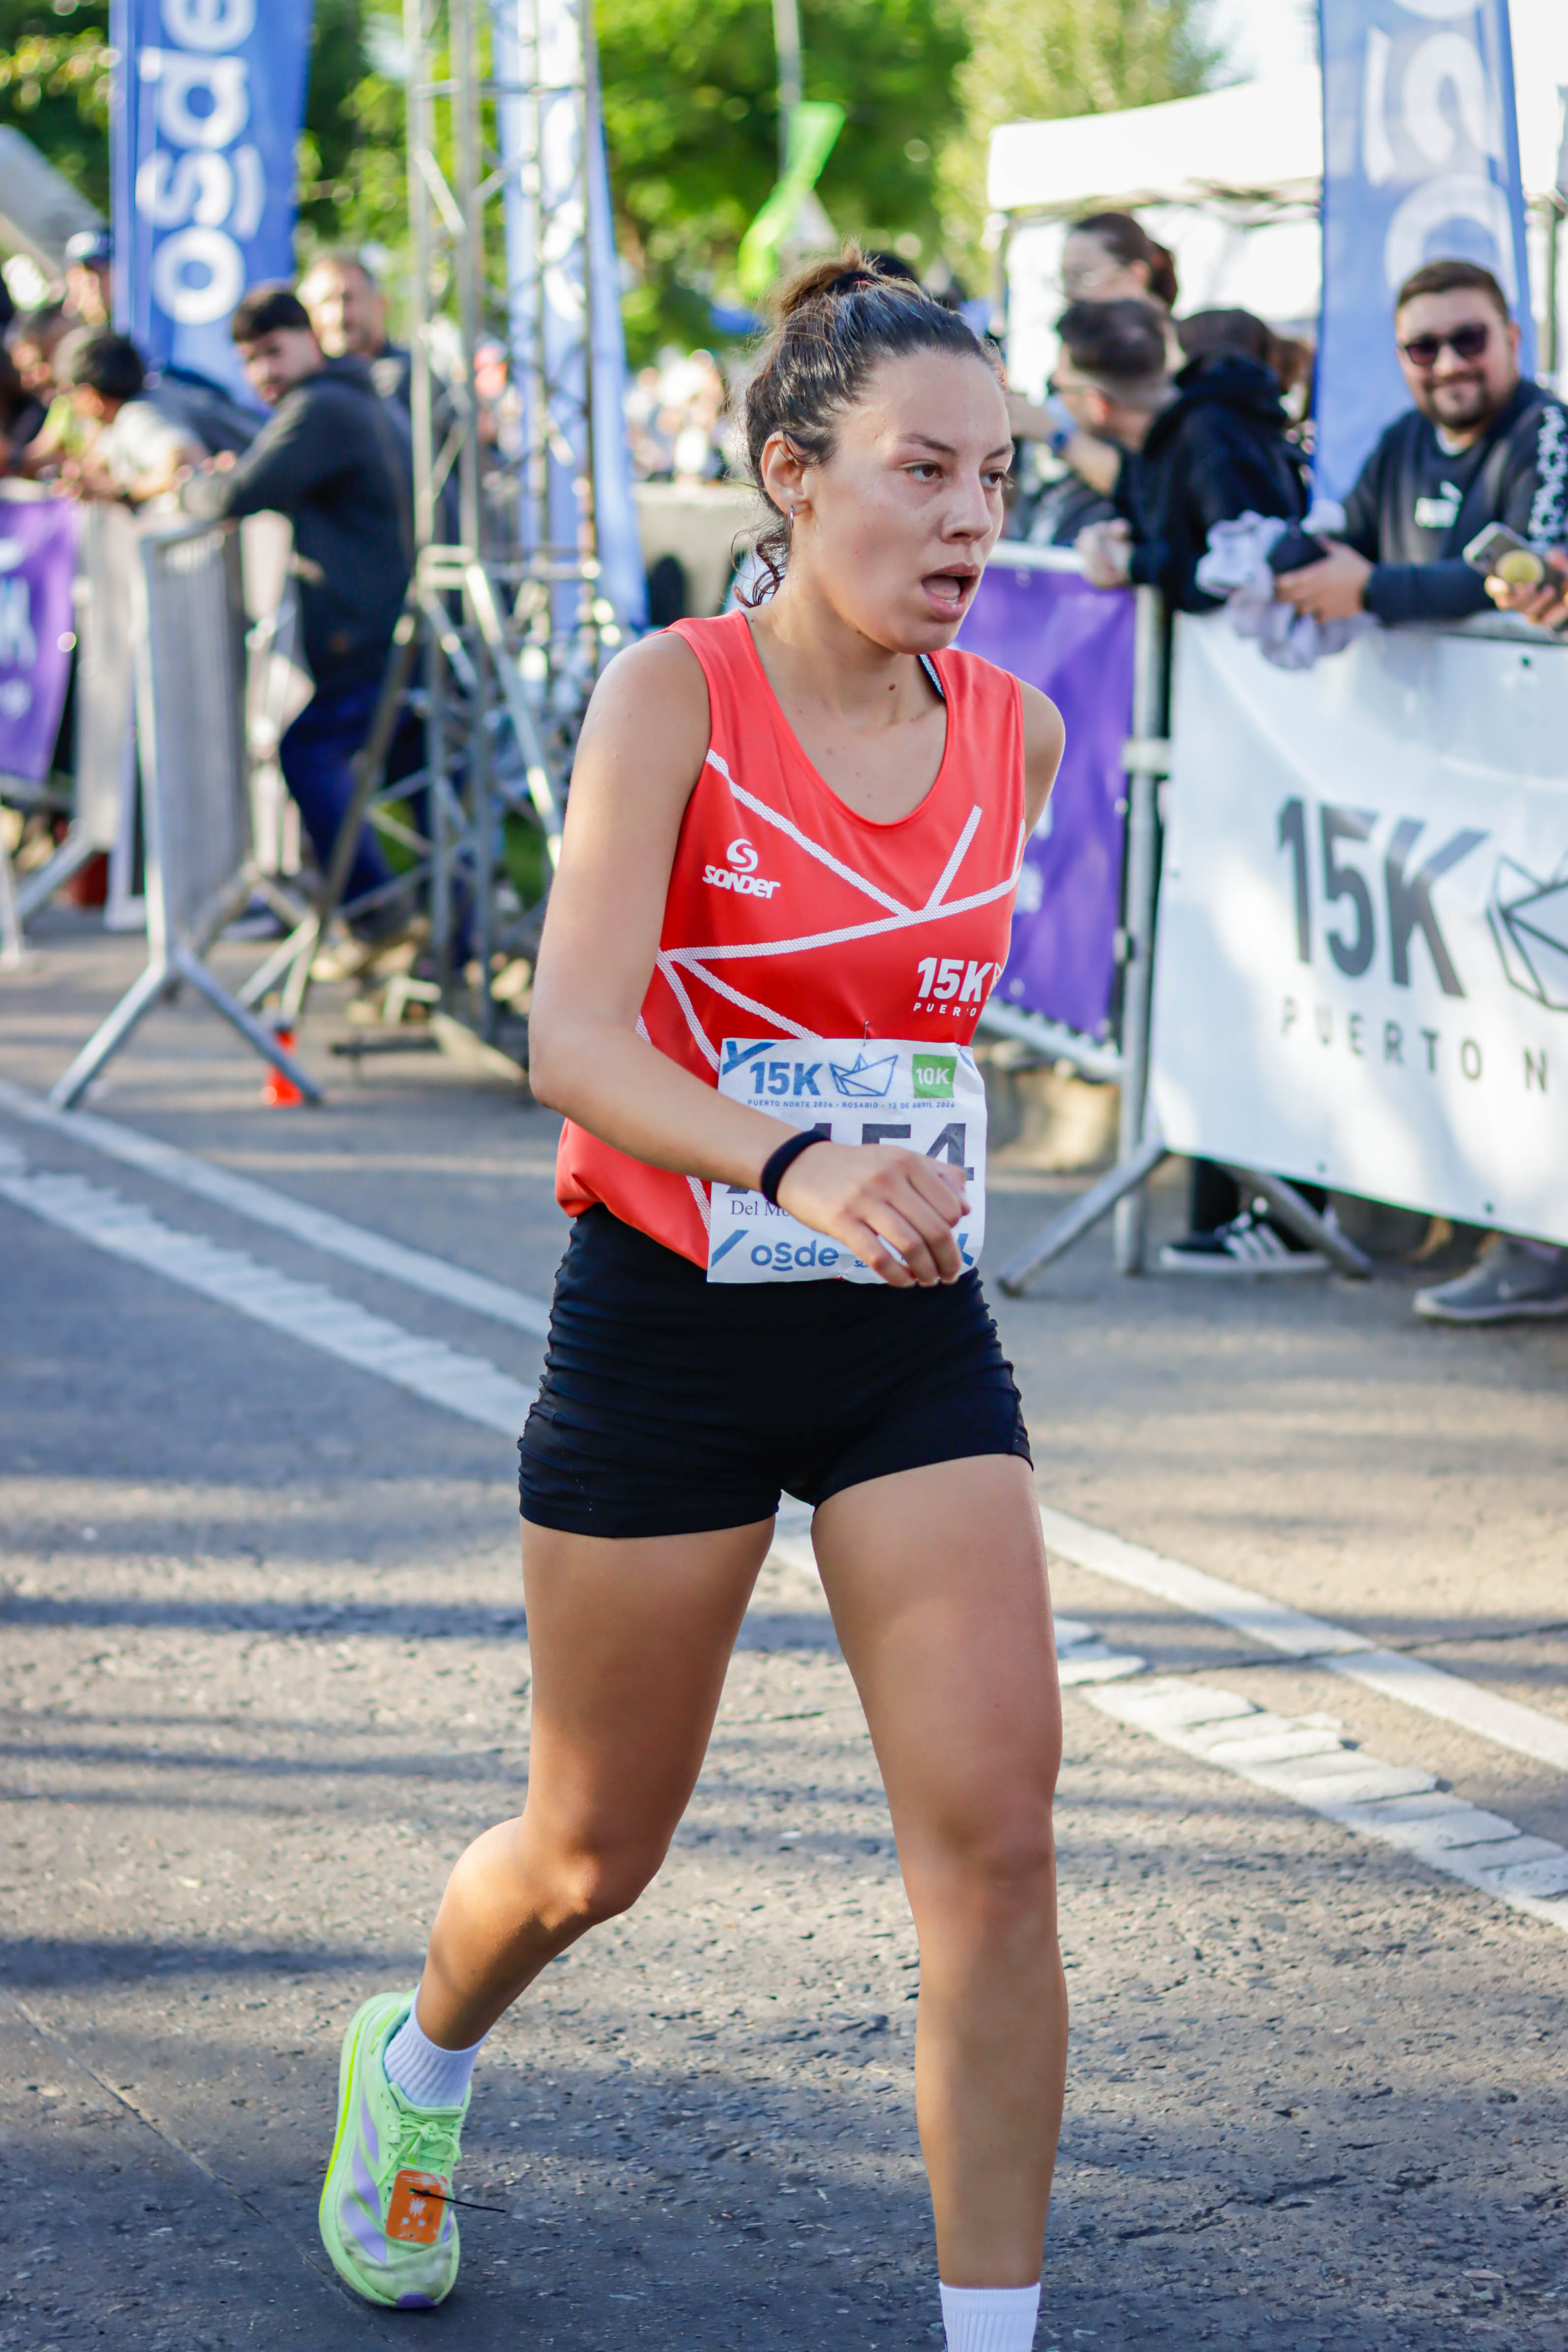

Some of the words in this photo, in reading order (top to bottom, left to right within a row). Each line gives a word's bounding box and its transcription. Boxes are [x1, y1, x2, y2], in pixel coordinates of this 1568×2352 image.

[1277, 795, 1490, 998] 15K
[917, 957, 994, 1002] 15K
[913, 1002, 977, 1017] PUERO
[1282, 997, 1481, 1081] PUERTO
[750, 1061, 823, 1096] 15K
[916, 1067, 949, 1085] 10K
[731, 1200, 758, 1216] Del
[751, 1239, 839, 1271] osde
